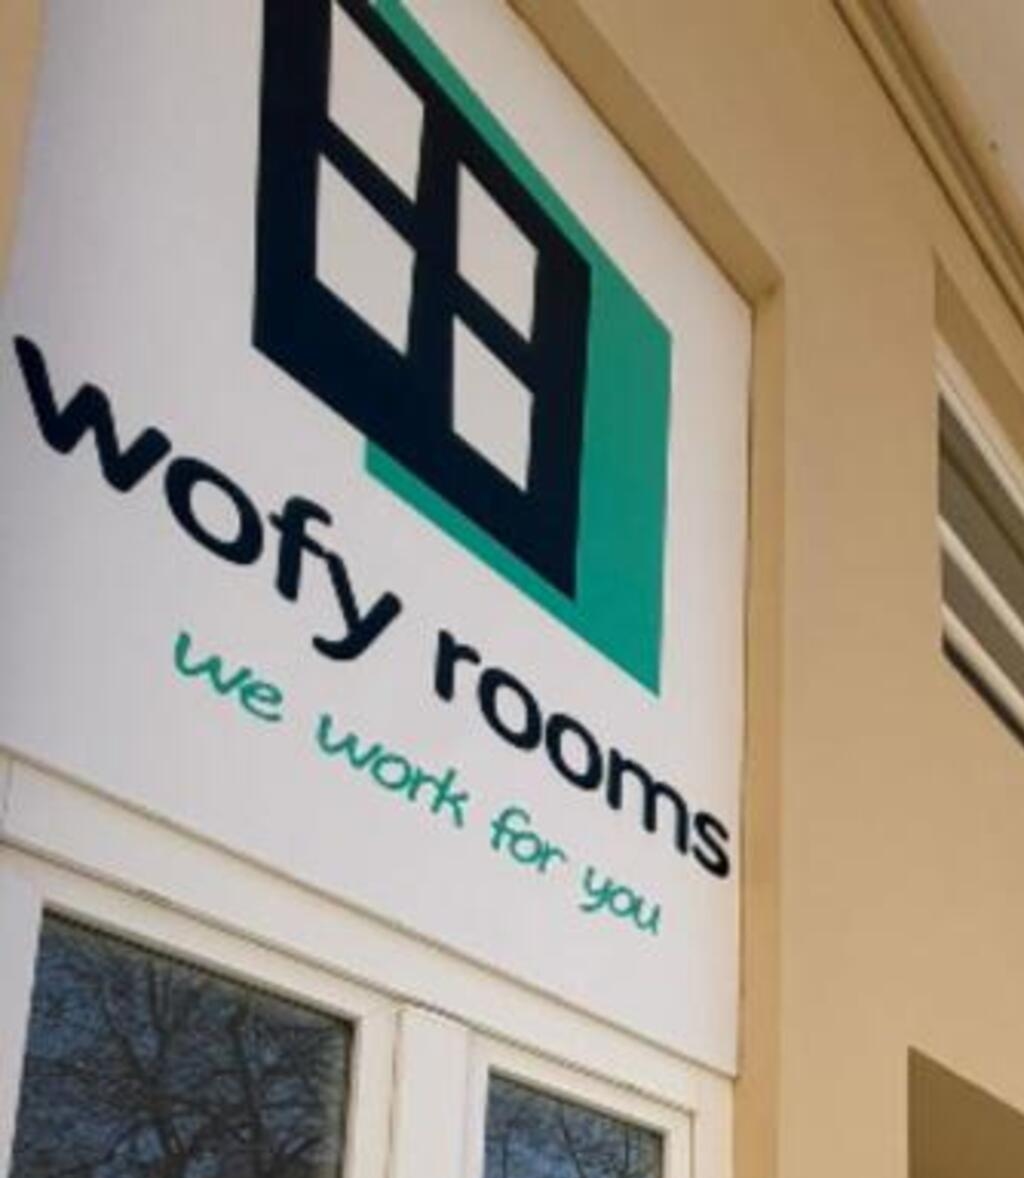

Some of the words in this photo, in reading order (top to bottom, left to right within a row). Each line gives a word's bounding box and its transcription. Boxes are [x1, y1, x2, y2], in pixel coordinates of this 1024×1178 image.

[13, 336, 403, 661] wofy
[435, 630, 731, 878] rooms
[174, 632, 283, 722] we
[315, 715, 468, 828] work
[491, 807, 566, 873] for
[579, 866, 661, 934] you
